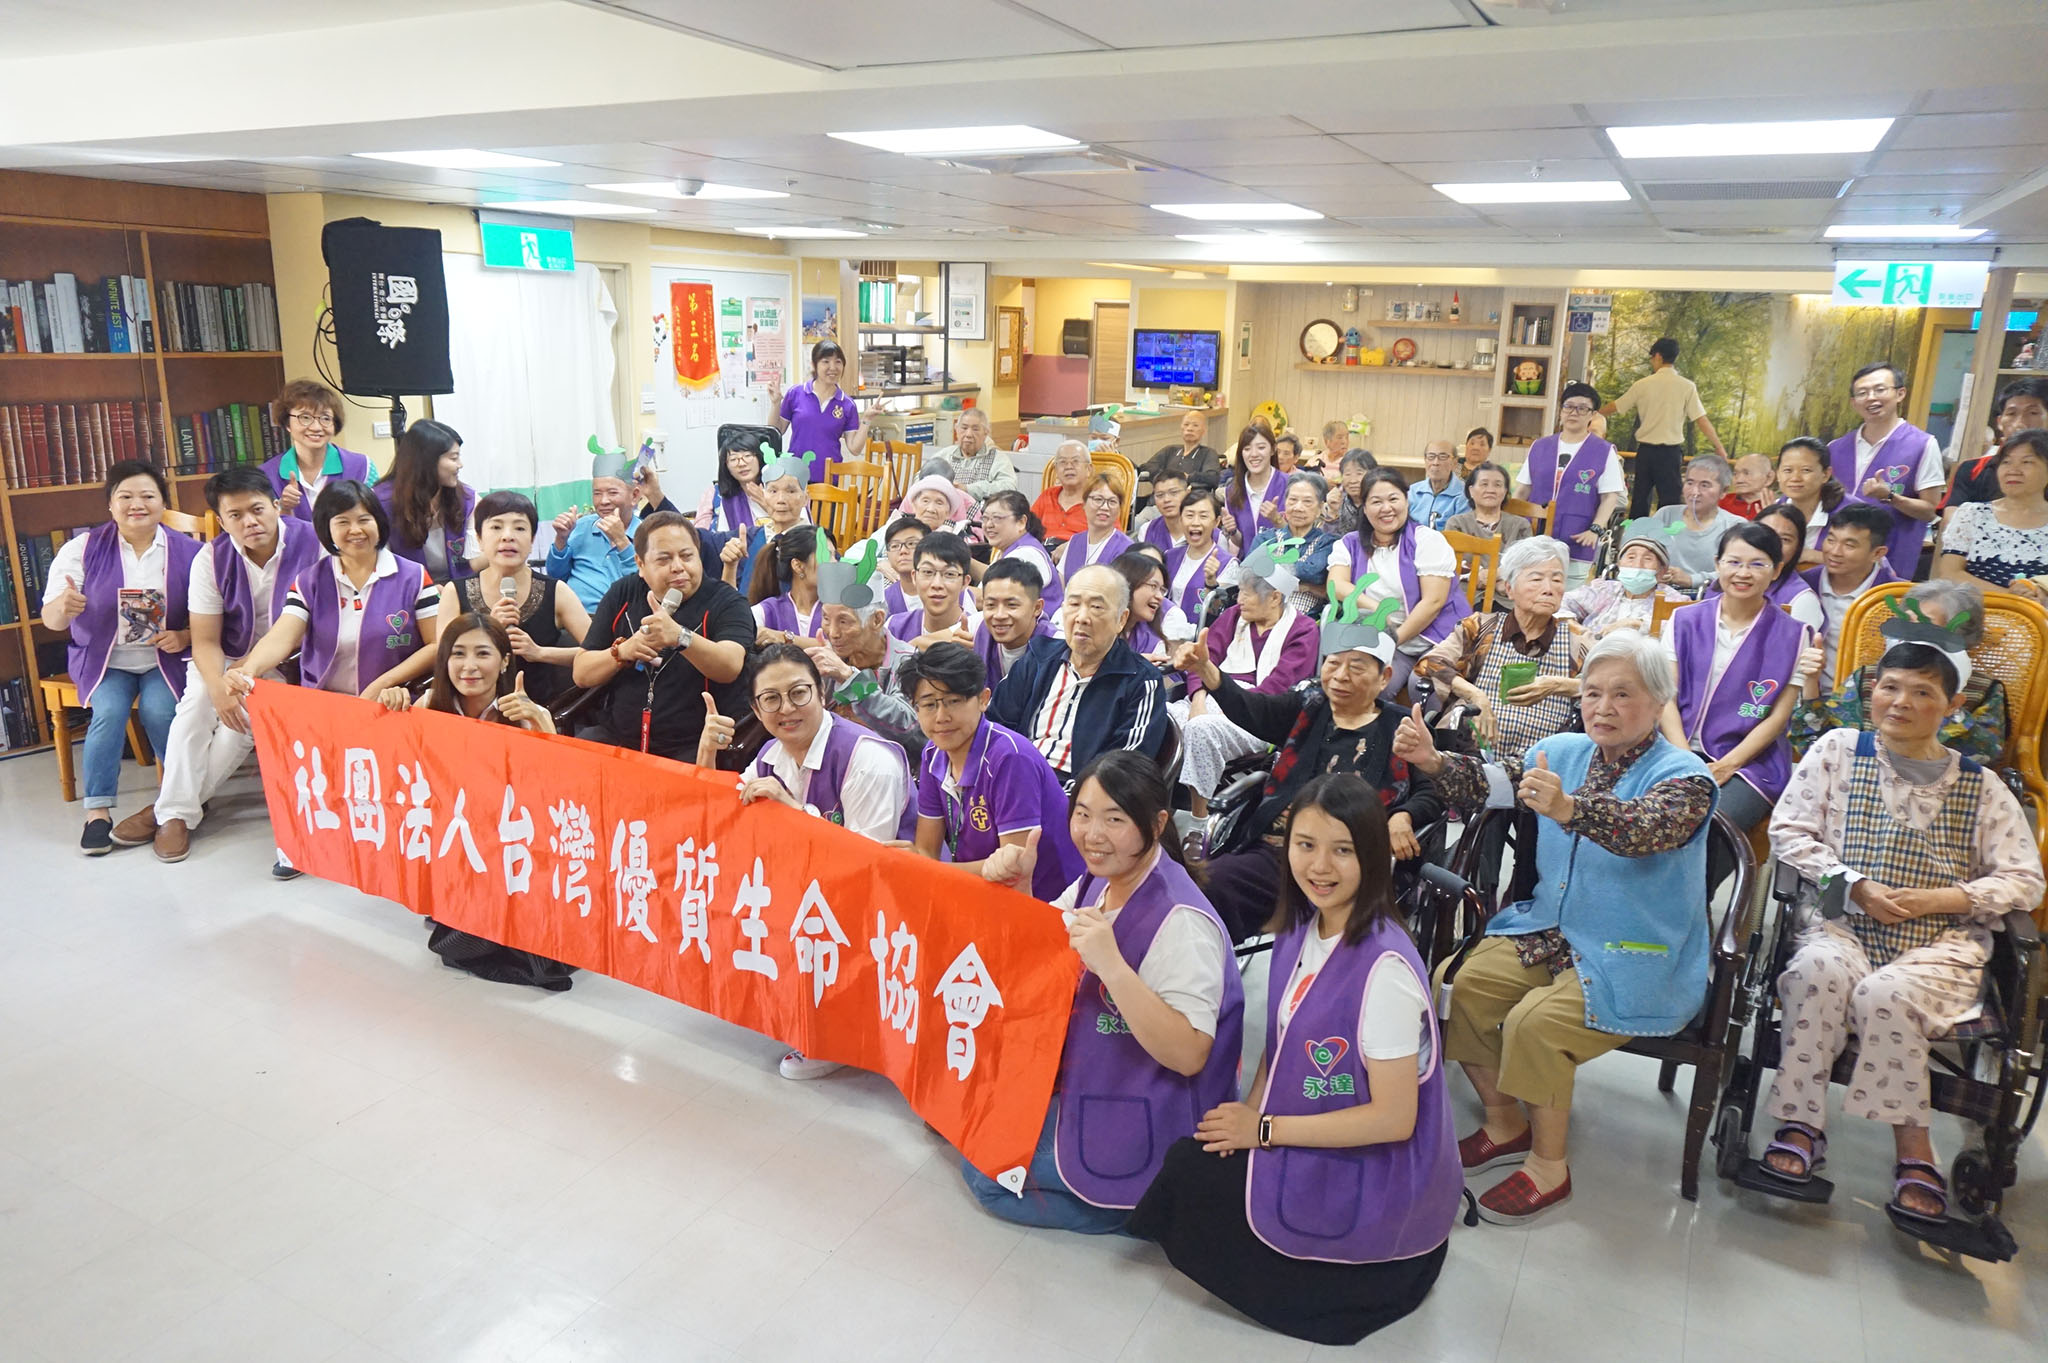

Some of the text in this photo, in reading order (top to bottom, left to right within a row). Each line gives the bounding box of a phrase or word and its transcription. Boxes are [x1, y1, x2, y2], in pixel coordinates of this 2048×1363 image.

[107, 278, 120, 310] INFINITE
[371, 272, 380, 320] INTERNATIONAL
[111, 309, 123, 329] JEST
[181, 428, 195, 457] LATIN
[18, 542, 33, 588] JOURNALISM
[293, 740, 1004, 1081] 社團法人台灣優質生命協會
[1302, 1073, 1356, 1099] 永達
